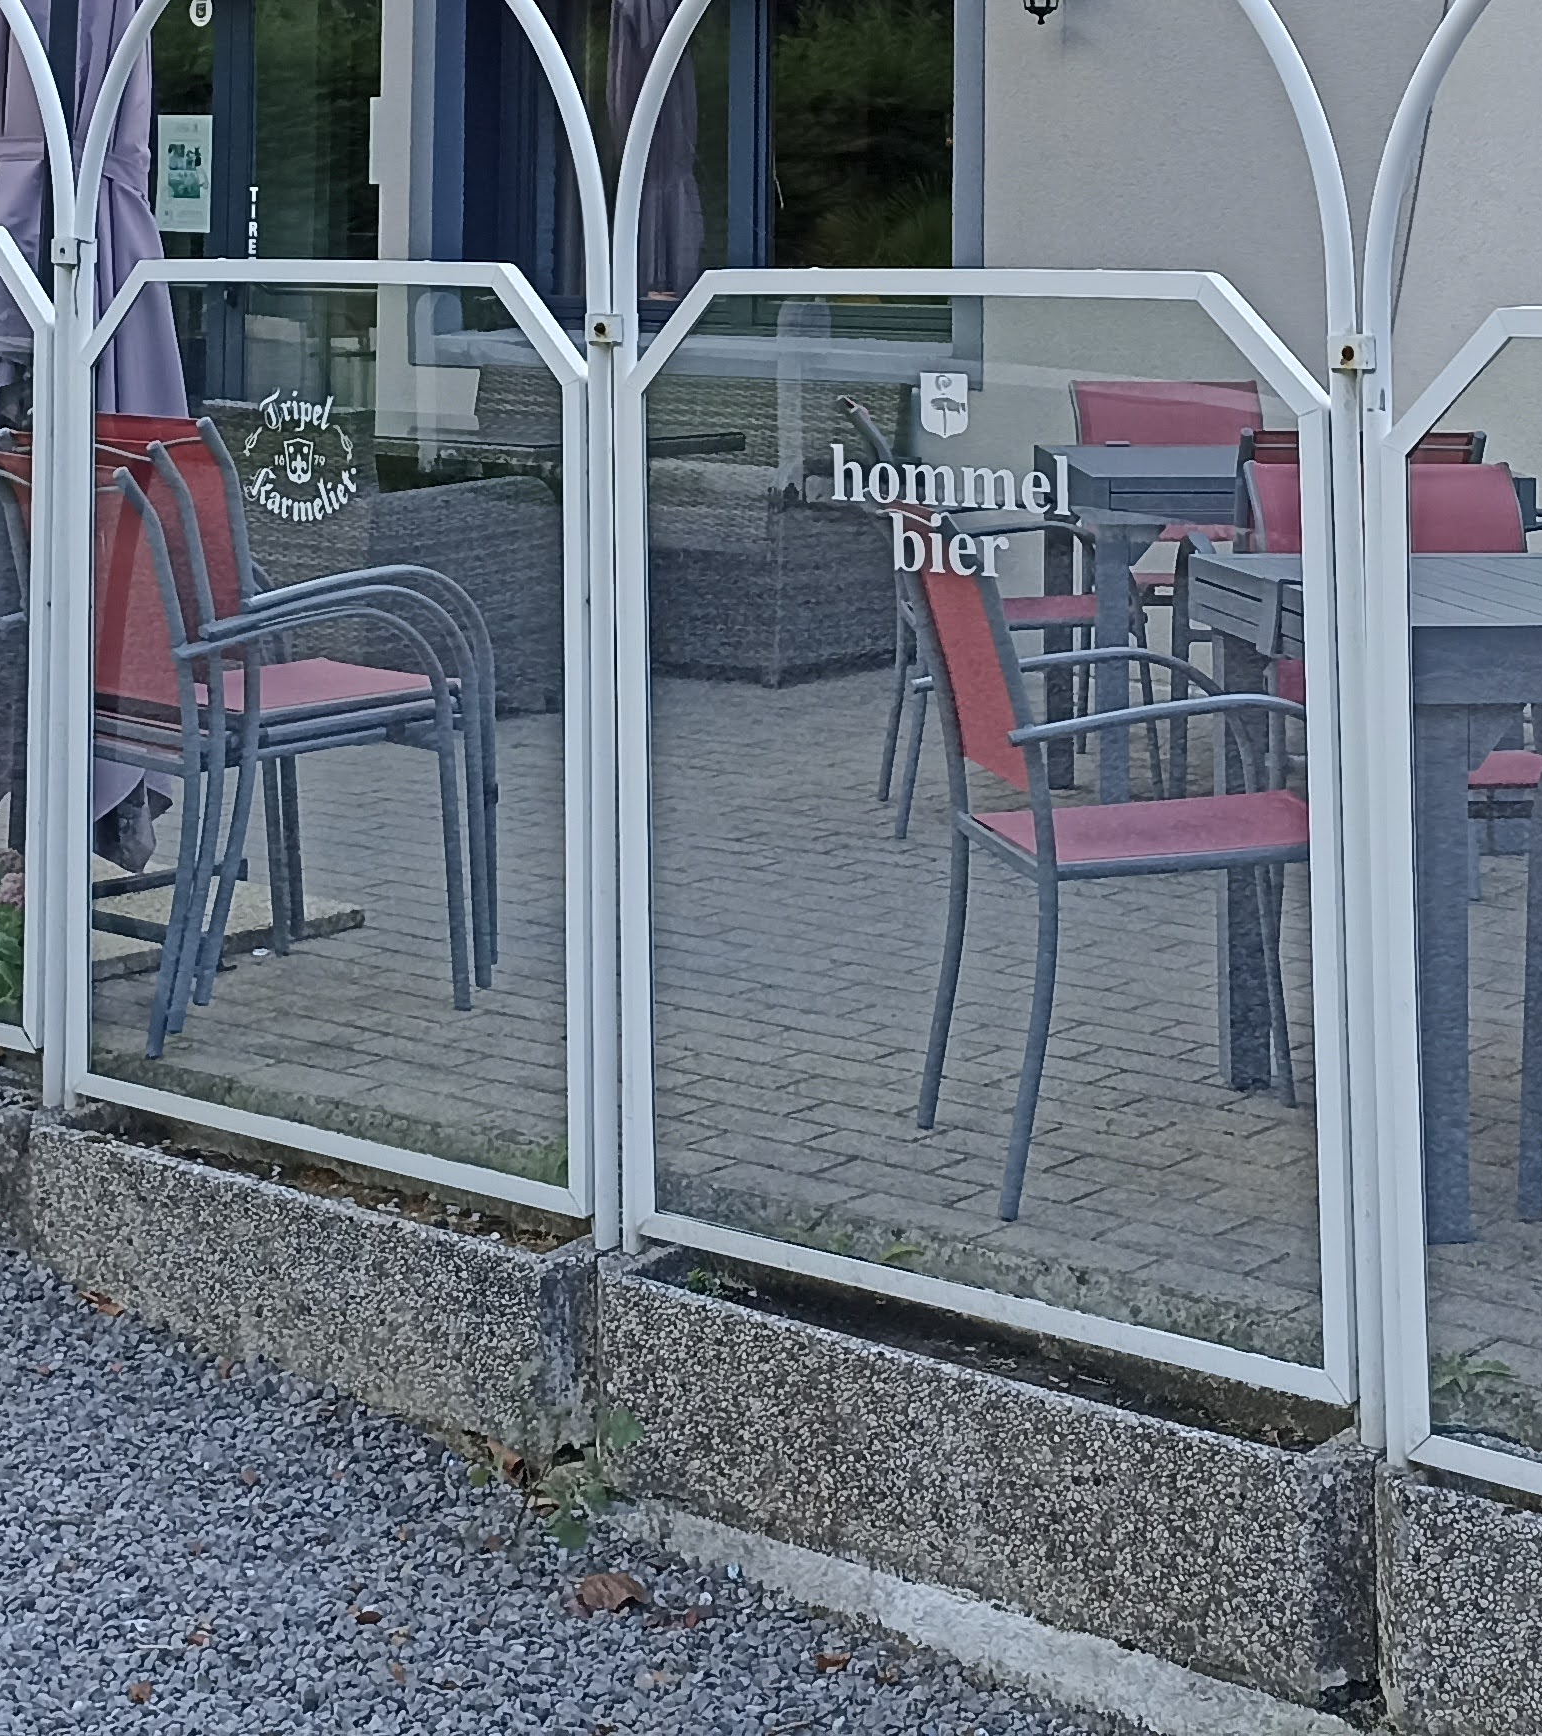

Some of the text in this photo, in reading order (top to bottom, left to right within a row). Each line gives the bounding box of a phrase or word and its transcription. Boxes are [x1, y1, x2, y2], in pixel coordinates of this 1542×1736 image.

[259, 386, 335, 433] Tripel
[830, 443, 1072, 516] hommel
[889, 512, 1010, 578] bier
